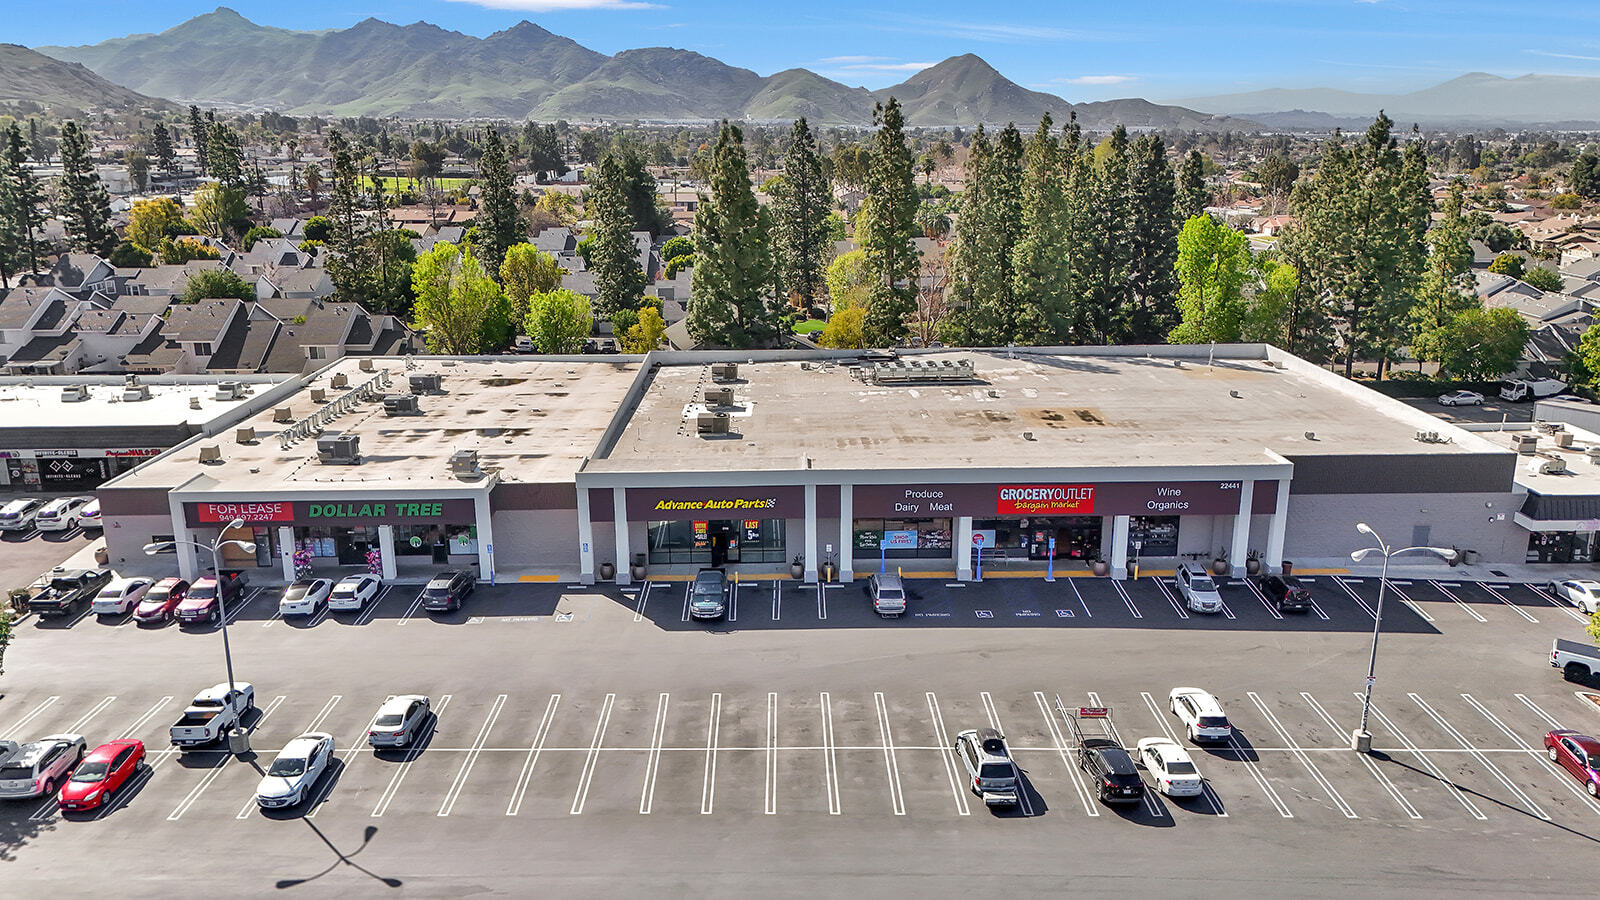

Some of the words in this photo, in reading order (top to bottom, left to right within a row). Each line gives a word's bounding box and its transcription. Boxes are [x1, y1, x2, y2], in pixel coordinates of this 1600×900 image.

[905, 489, 944, 499] Produce
[1157, 487, 1181, 496] Wine
[209, 504, 237, 514] FOR
[240, 503, 282, 514] LEASE
[655, 500, 703, 510] Advance
[704, 499, 734, 509] Auto
[734, 499, 765, 509] Parts
[895, 502, 919, 513] Dairy
[929, 502, 953, 511] Meat
[1014, 499, 1049, 512] bargain
[1050, 500, 1080, 509] market
[1147, 500, 1189, 511] Organics
[309, 504, 386, 518] DOLLAR
[395, 503, 443, 516] TREE
[745, 521, 758, 529] LAST
